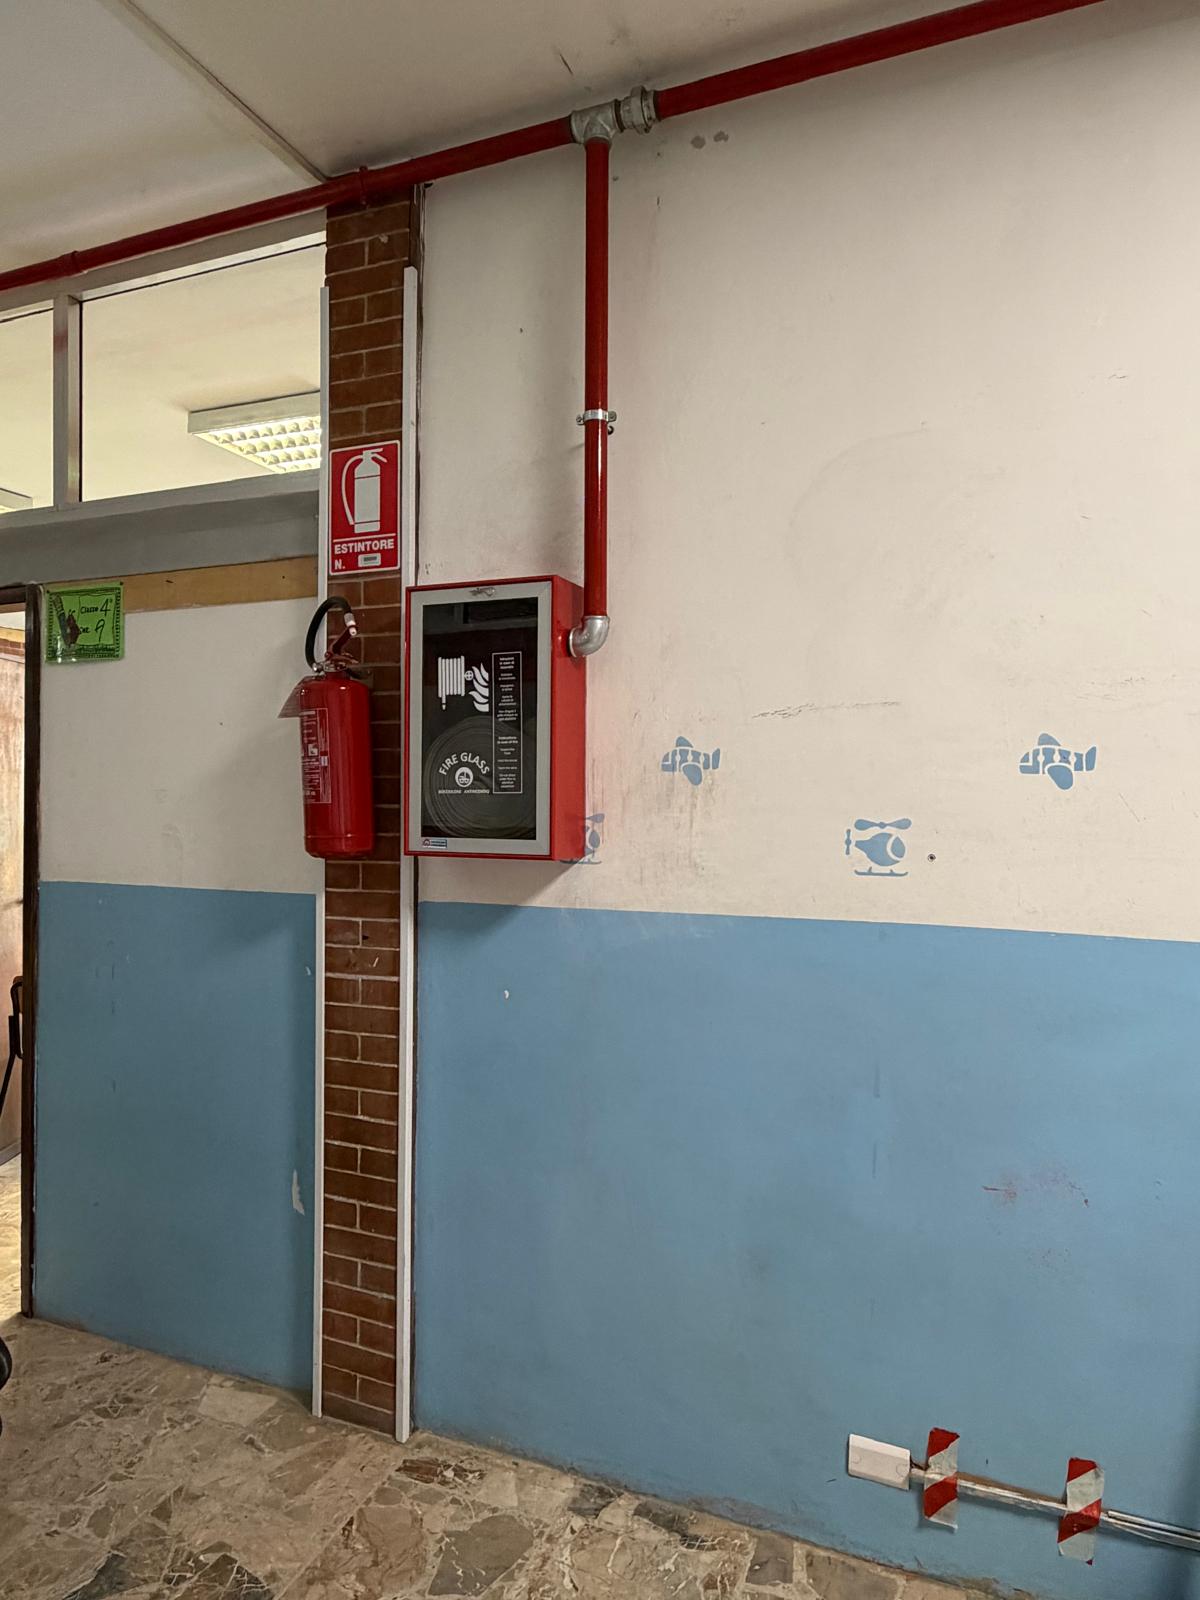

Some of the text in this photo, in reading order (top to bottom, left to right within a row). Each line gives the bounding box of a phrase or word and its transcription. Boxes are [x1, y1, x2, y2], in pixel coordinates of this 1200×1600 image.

[334, 538, 395, 555] ESTINTORE
[334, 559, 346, 570] N.
[438, 752, 490, 775] FIRE GLASS
